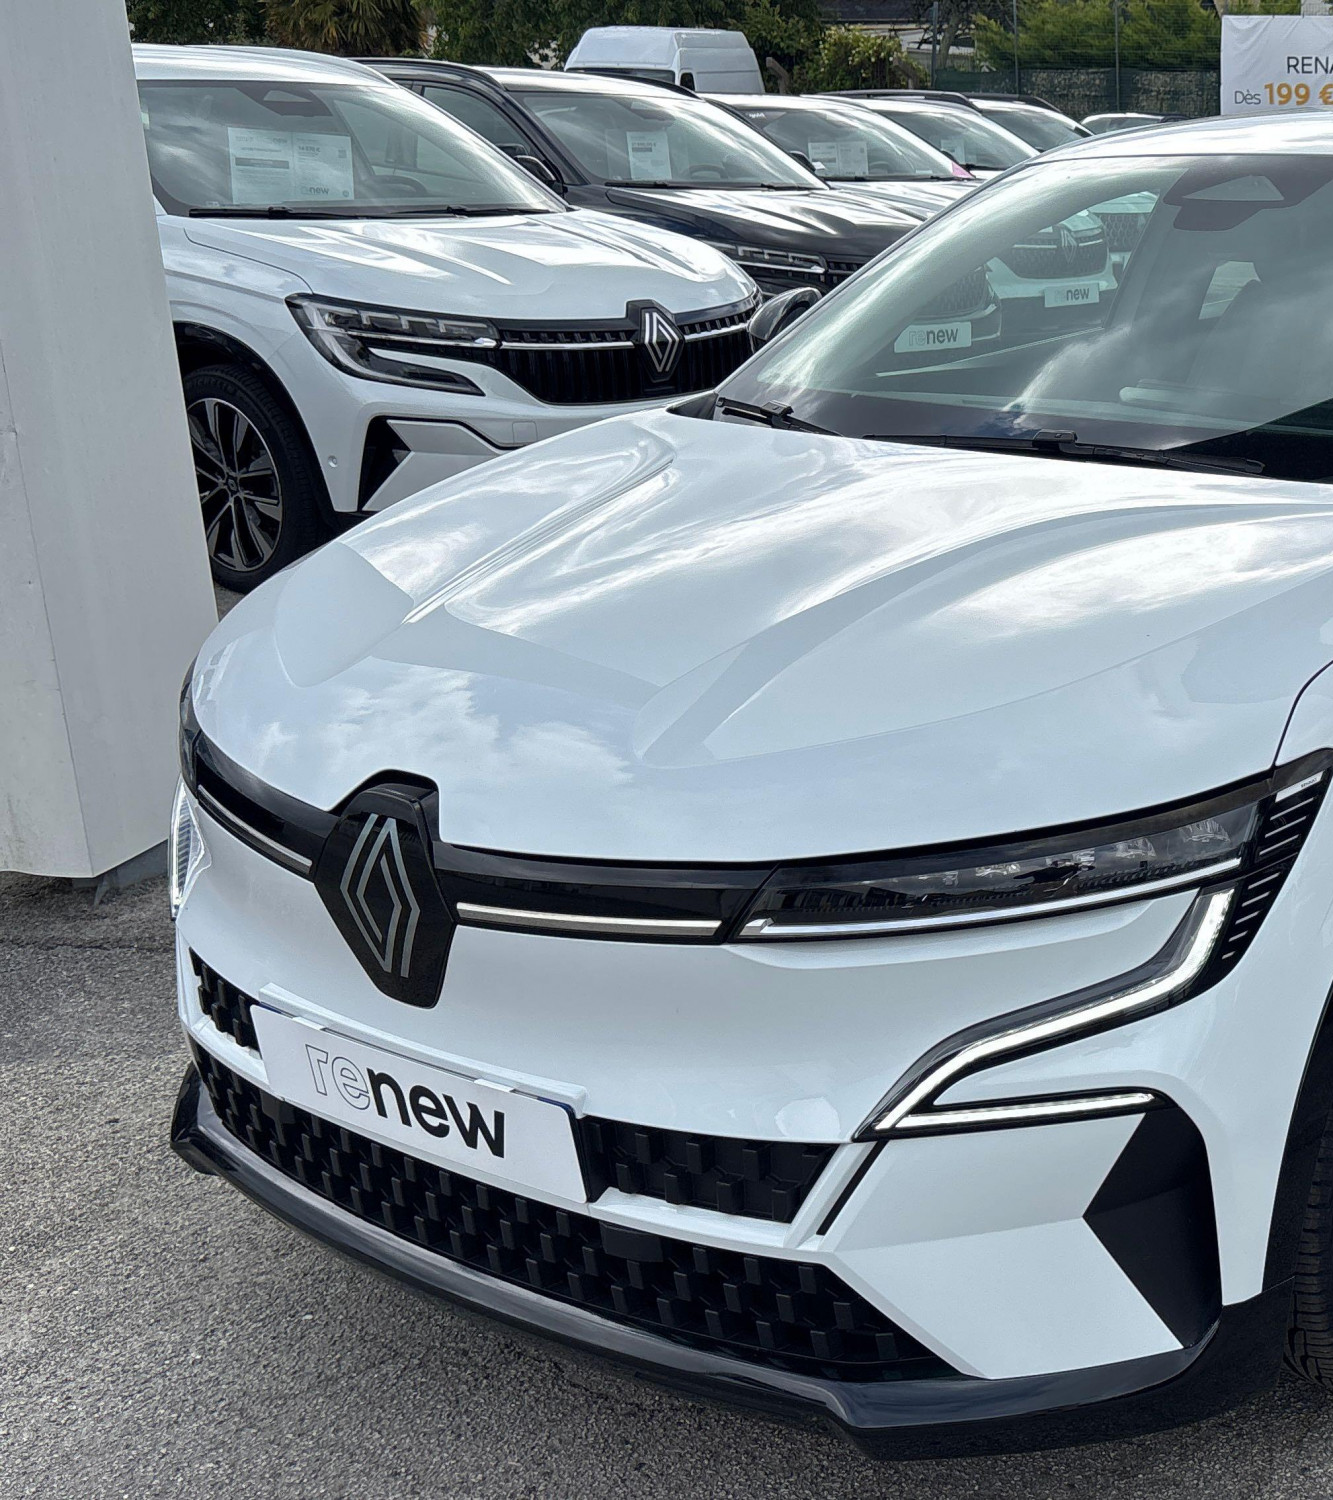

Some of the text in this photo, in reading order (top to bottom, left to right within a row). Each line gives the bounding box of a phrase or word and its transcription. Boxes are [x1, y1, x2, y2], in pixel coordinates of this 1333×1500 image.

[1234, 89, 1262, 105] Dès
[1264, 82, 1311, 106] 199
[908, 328, 959, 347] renew
[305, 1043, 505, 1159] renew
